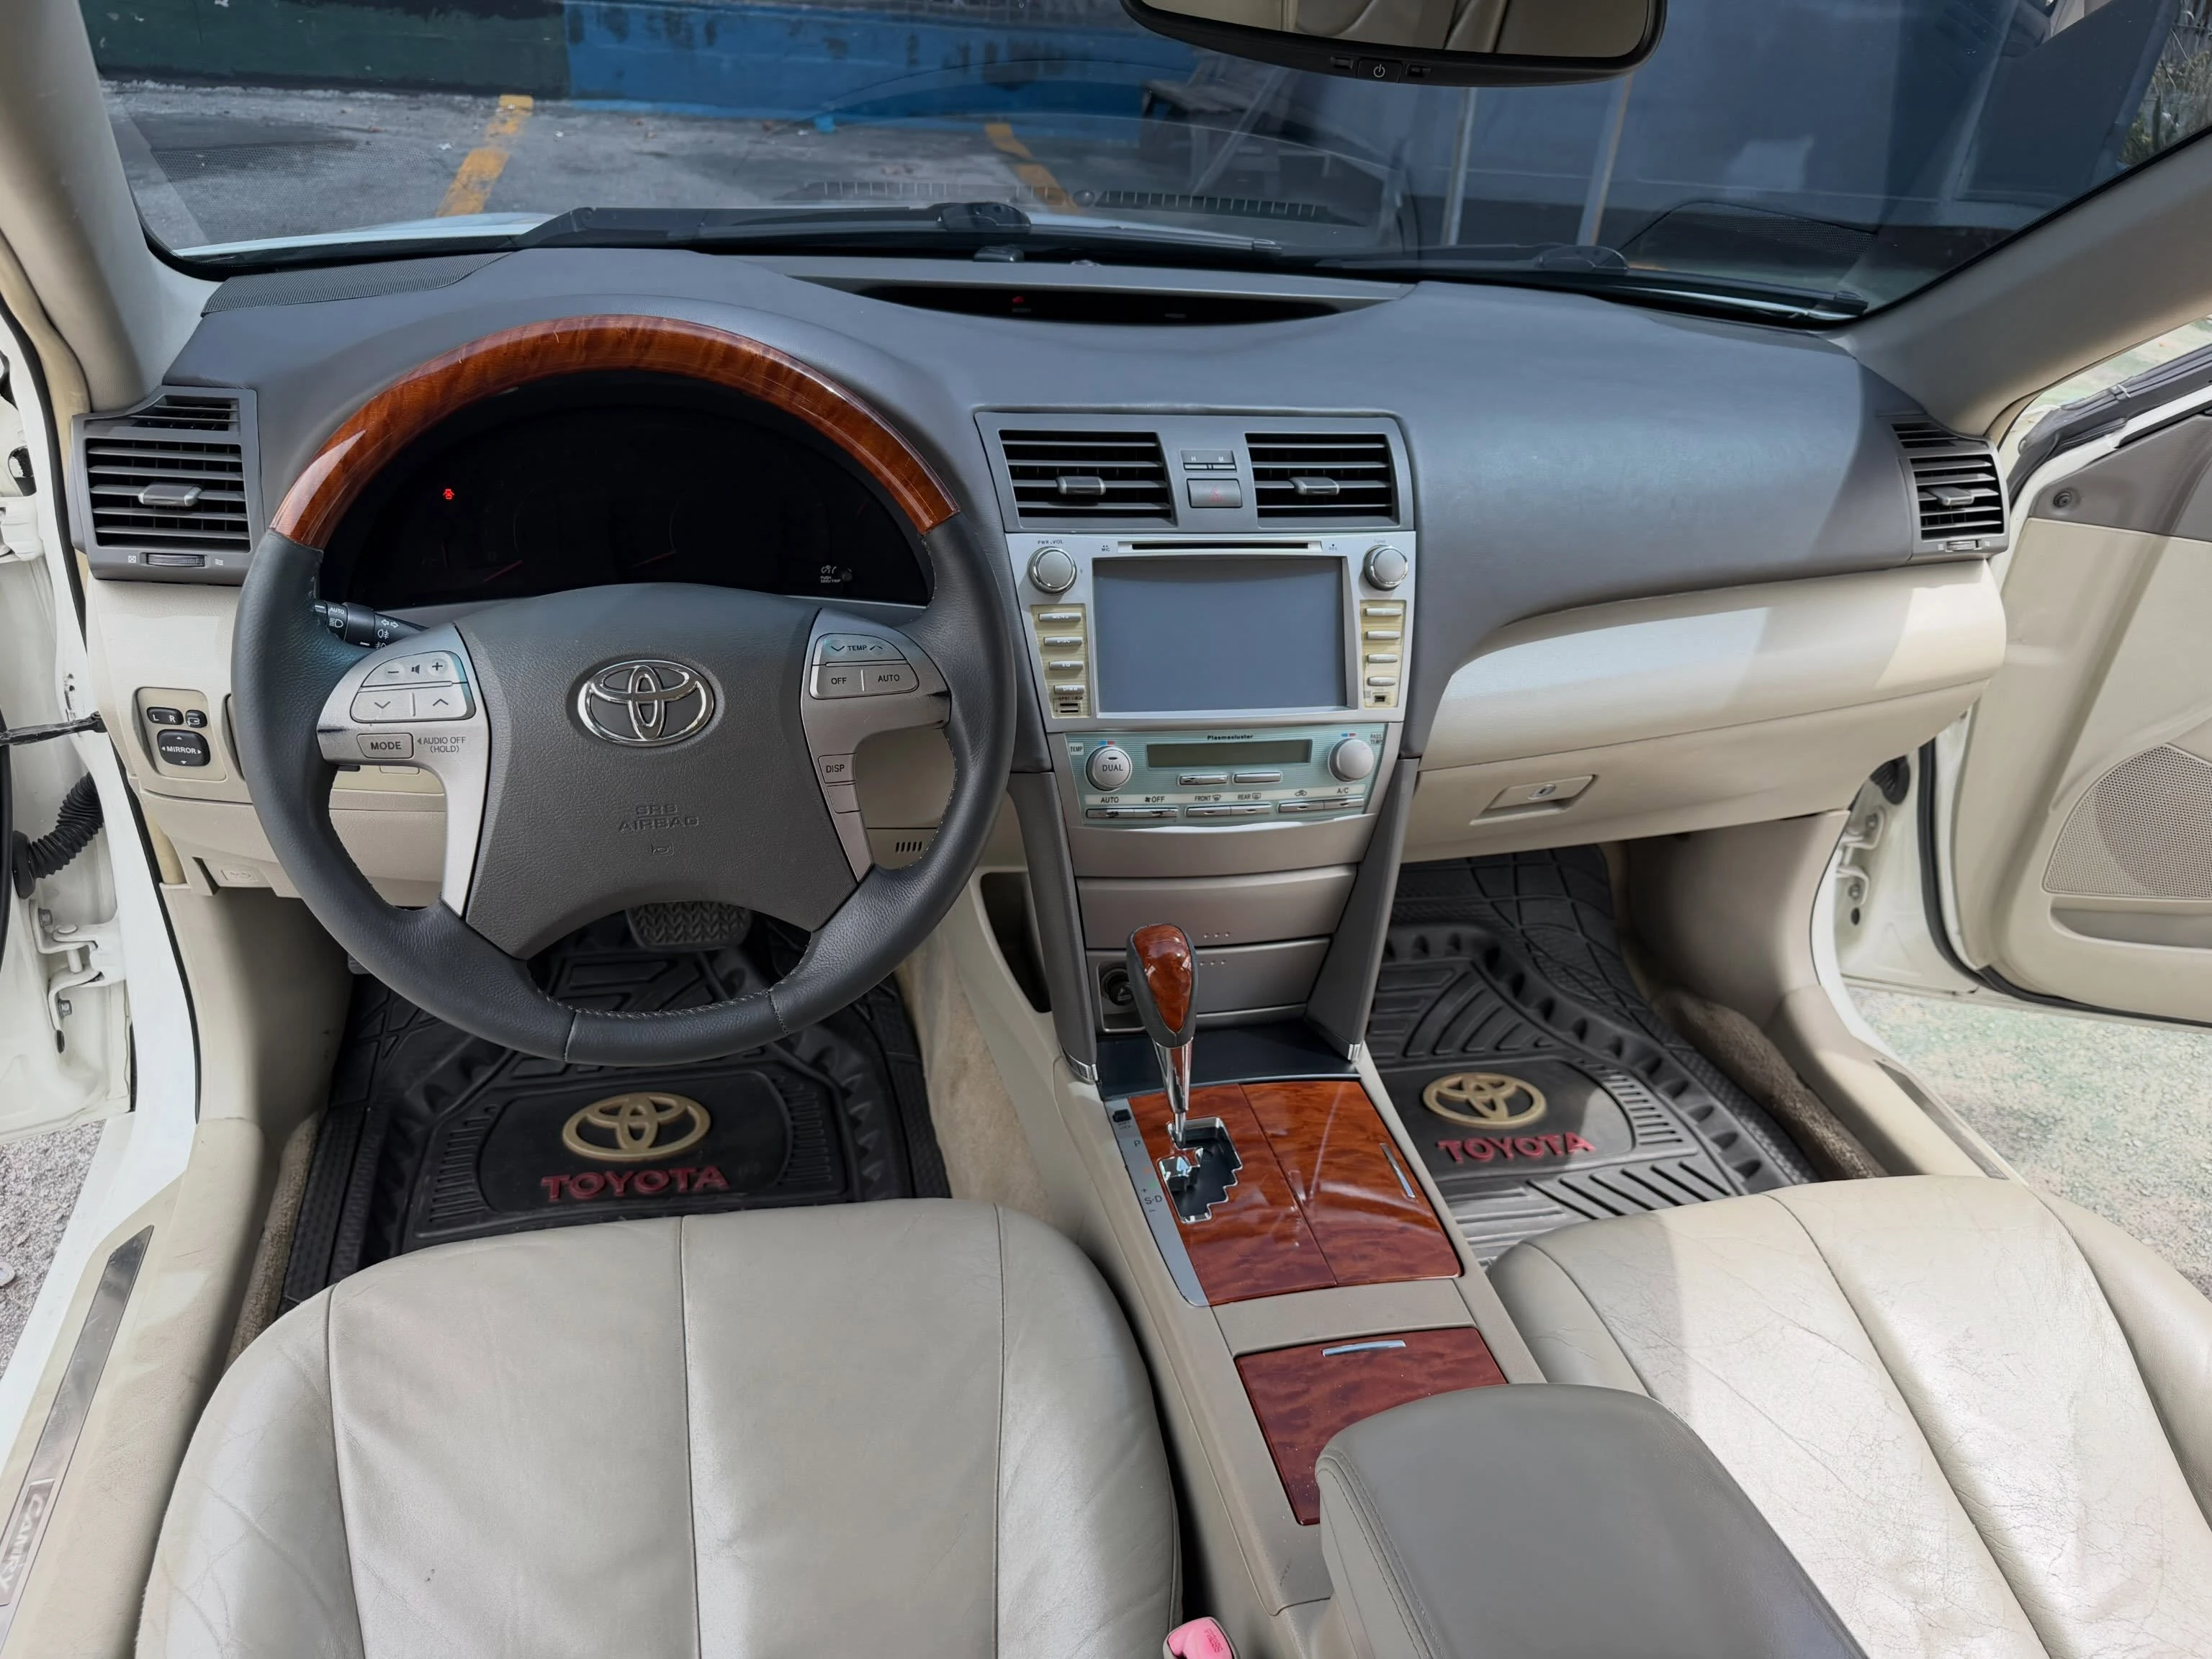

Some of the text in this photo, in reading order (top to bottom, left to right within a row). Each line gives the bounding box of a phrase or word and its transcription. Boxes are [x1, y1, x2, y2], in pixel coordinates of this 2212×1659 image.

[878, 674, 900, 683] AUTO
[168, 714, 176, 723] R
[166, 746, 197, 755] MIRROR
[370, 741, 402, 750] MODE
[826, 764, 845, 773] DISP
[636, 804, 678, 815] SRS
[619, 815, 700, 832] AIRBAG
[1437, 1131, 1596, 1164] TOYOTA
[541, 1164, 729, 1202] TOYOTA
[0, 1493, 43, 1593] CAMRY
